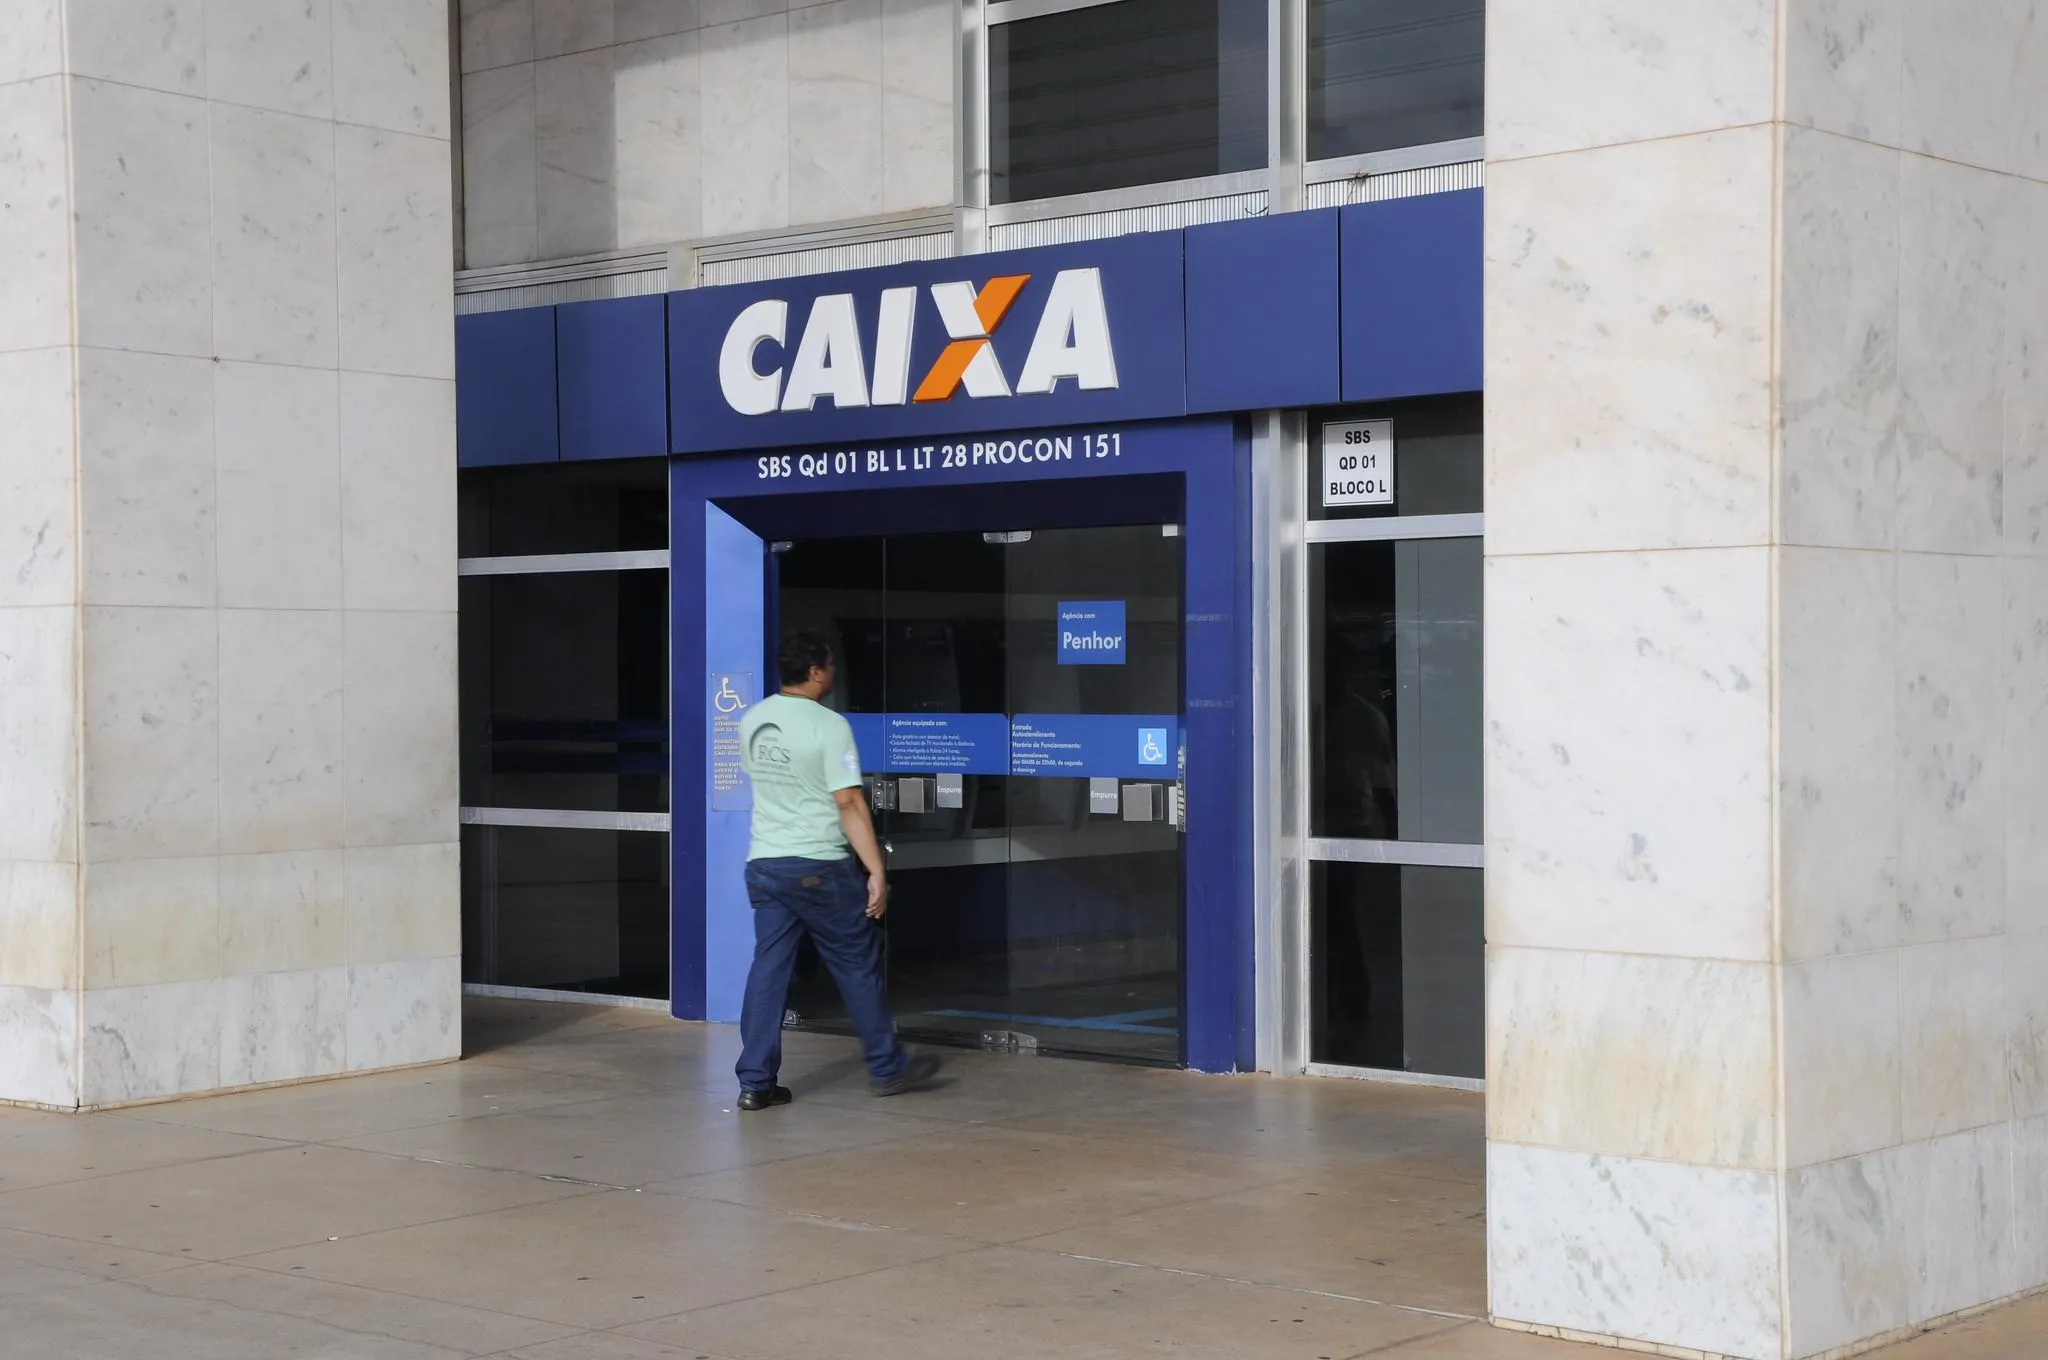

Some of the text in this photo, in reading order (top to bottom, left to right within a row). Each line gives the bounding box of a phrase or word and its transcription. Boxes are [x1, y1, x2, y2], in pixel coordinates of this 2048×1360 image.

[719, 267, 1119, 416] CAIXA
[1345, 430, 1371, 444] SBS
[758, 433, 1120, 478] SBS Qd 01 BL L LT 28 PROCON 151
[1339, 454, 1376, 470] QD 01
[1330, 479, 1387, 495] BLOCO L
[1063, 630, 1122, 650] Penhor
[758, 744, 791, 764] RCS
[1090, 790, 1118, 799] Empurre
